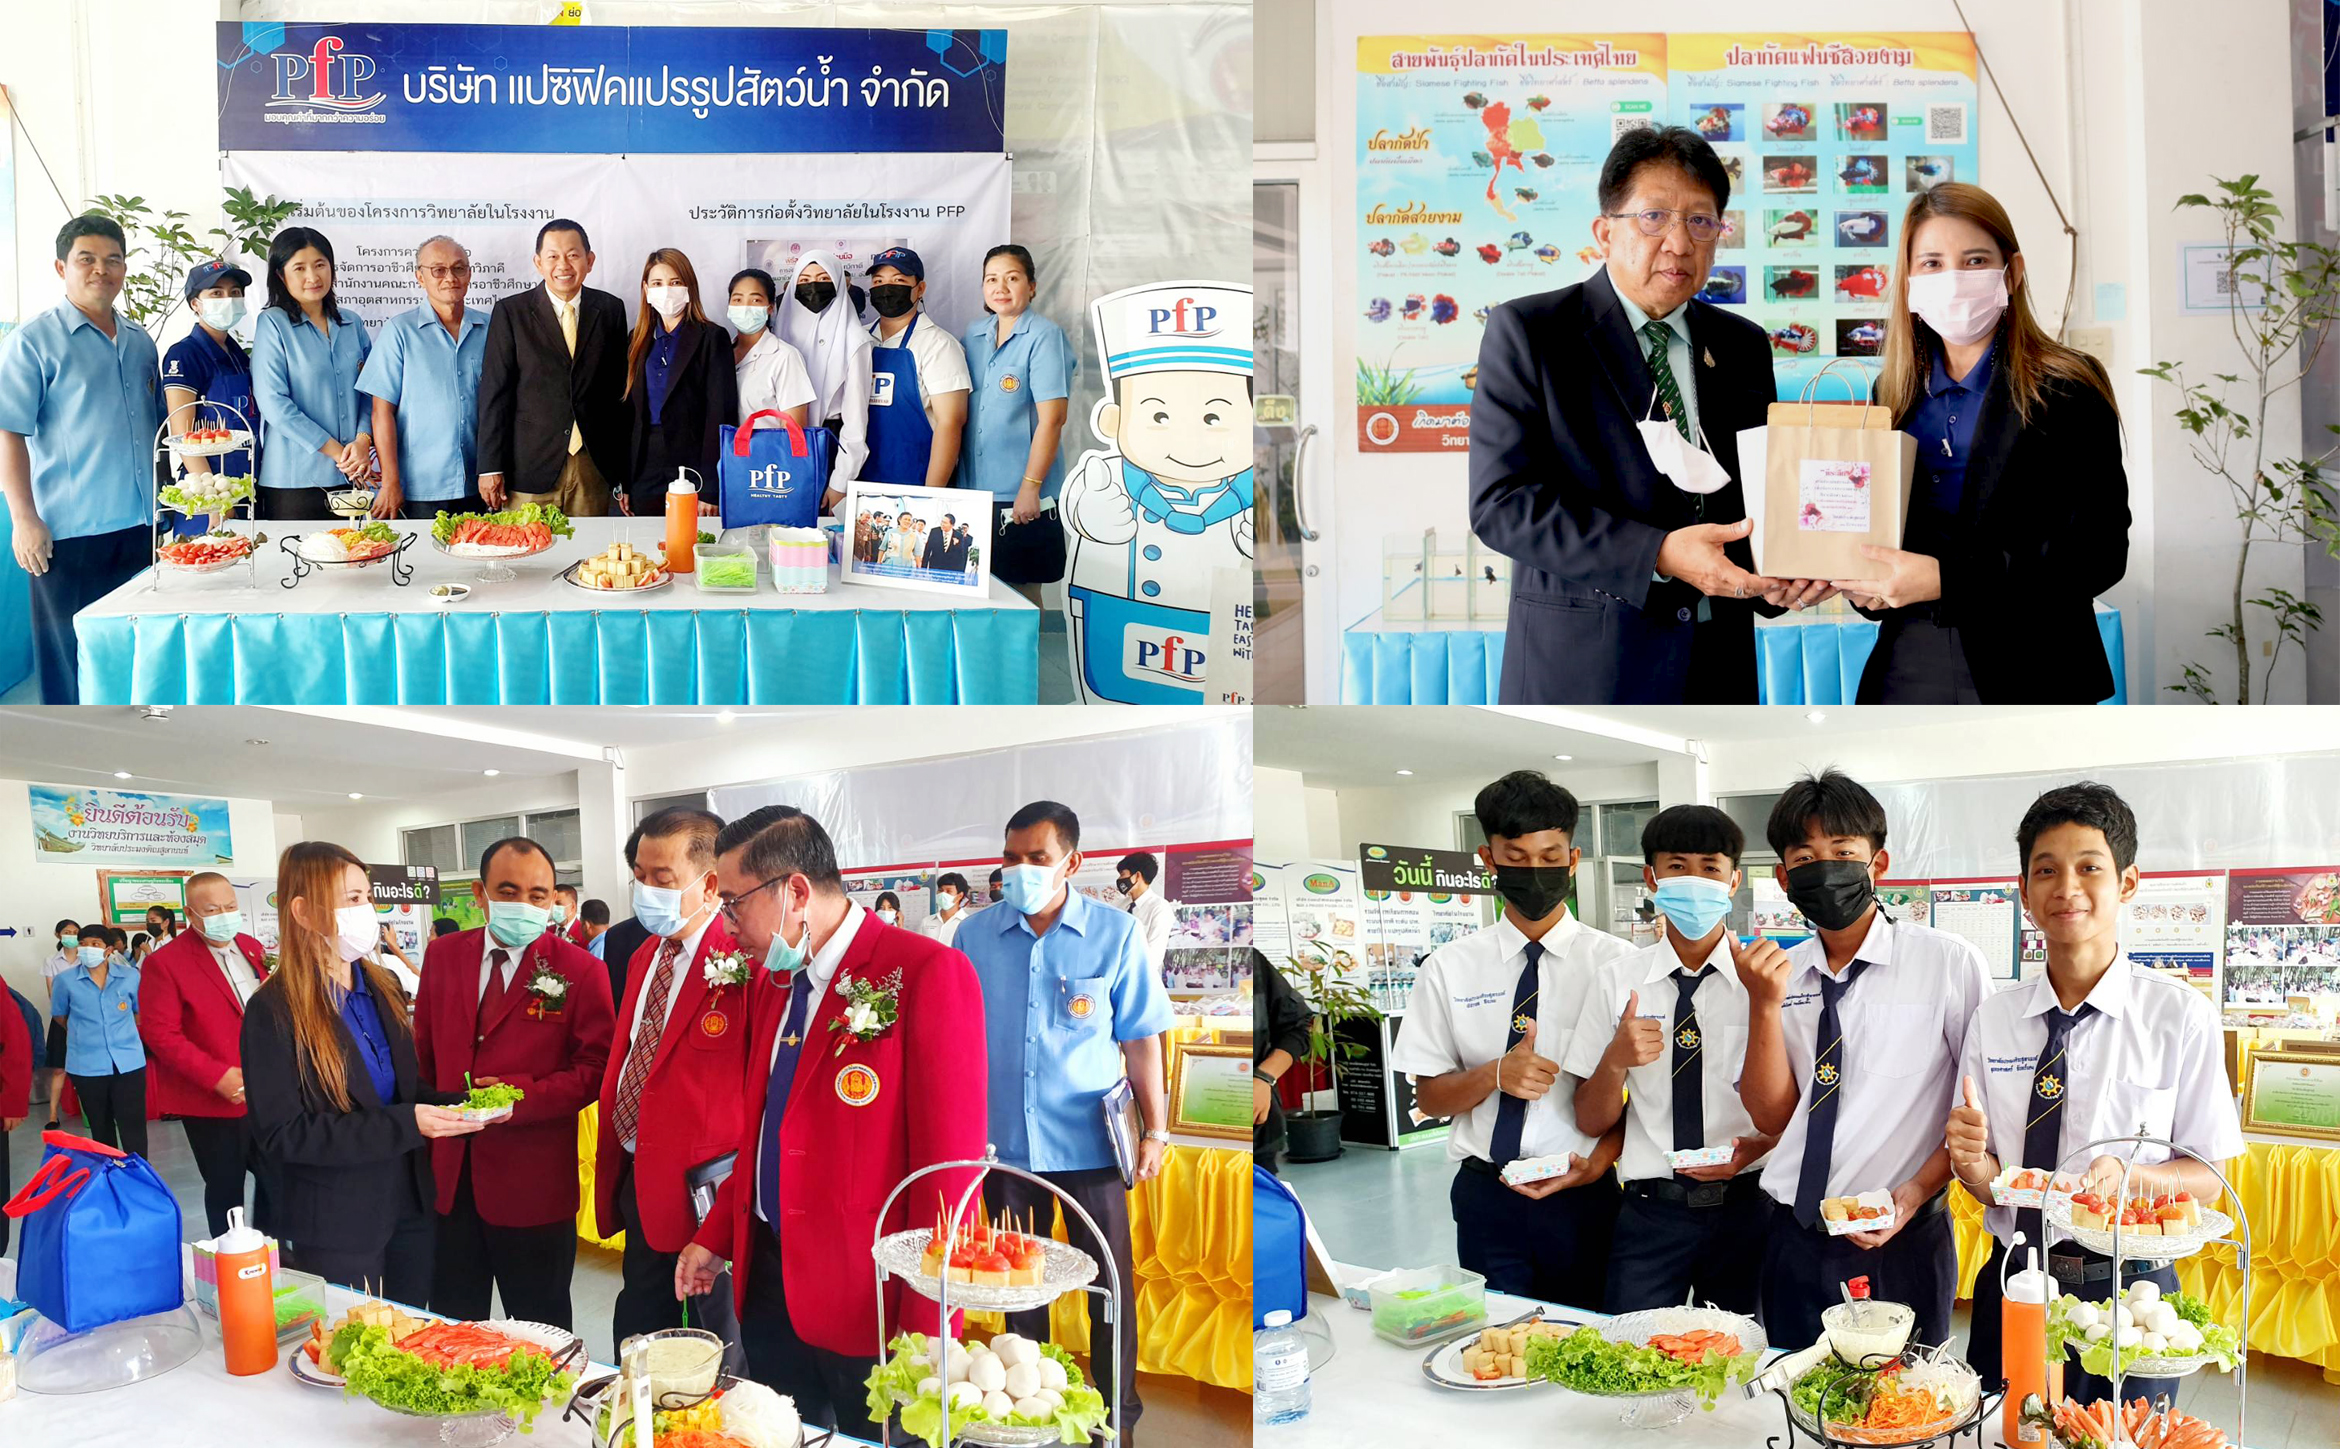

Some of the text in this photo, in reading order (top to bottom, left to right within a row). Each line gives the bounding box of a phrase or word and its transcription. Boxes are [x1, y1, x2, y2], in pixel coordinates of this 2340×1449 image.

[271, 36, 376, 100] PfP
[1390, 42, 1638, 72] สายพันธุ์ปลากัดในประเทศไทย
[1724, 43, 1911, 67] ปลากัดแฟนซีสวยงาม
[403, 55, 949, 119] บริษัท แปซิฟิคแปรรูปสัตว์น้ำ จำกัด
[689, 199, 965, 220] ประวัติการก่อตั้งวิทยาลัยในโรงงาน PFP
[1366, 201, 1462, 224] ปลากัดสวยงาม
[1147, 297, 1217, 334] PfP
[749, 463, 791, 489] PfP
[1235, 604, 1253, 619] HE
[1136, 636, 1206, 677] PfP
[84, 801, 191, 828] ยินดีต้อนรับ
[67, 827, 207, 847] งานวิทยบริการและห้องสมุด
[1393, 855, 1433, 886] วันนี้
